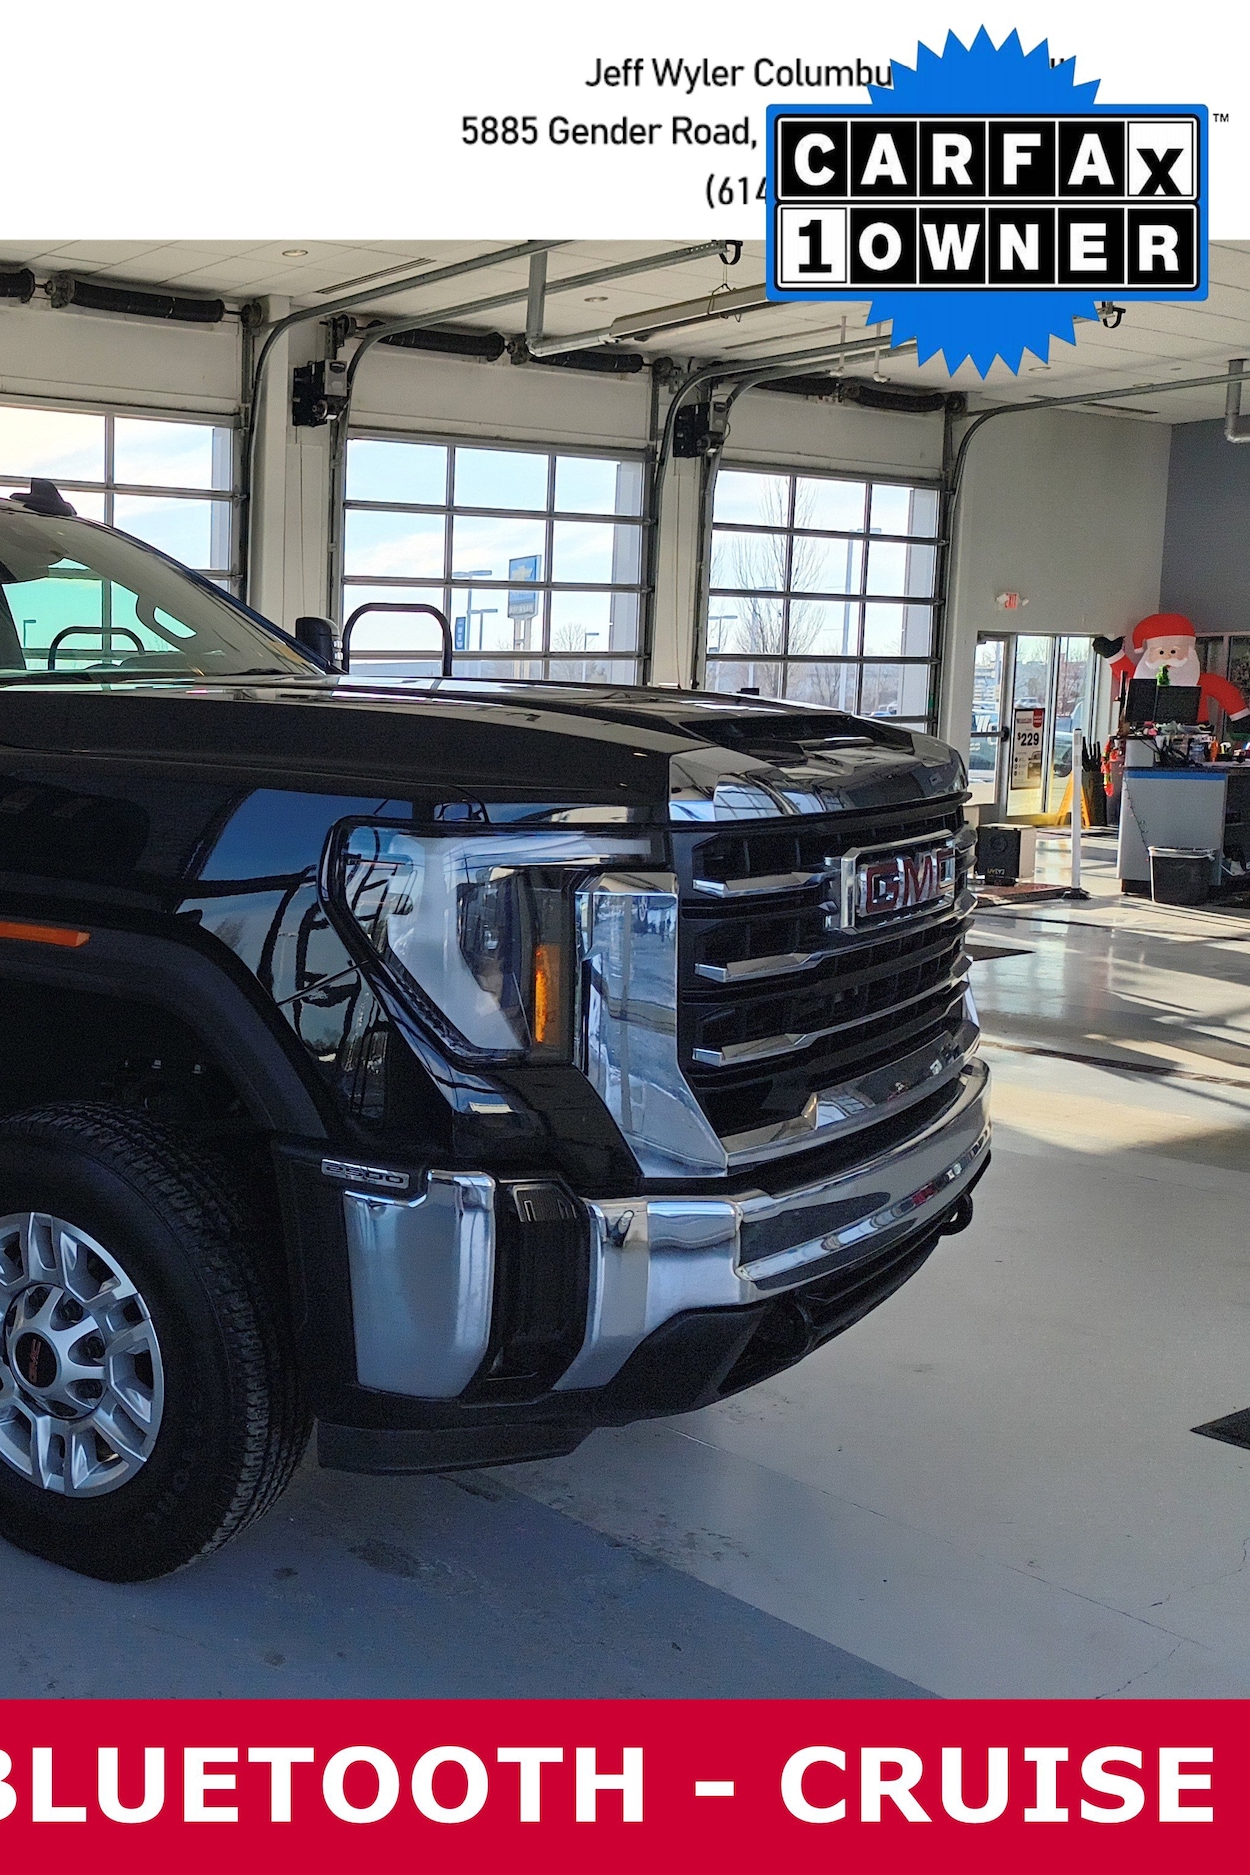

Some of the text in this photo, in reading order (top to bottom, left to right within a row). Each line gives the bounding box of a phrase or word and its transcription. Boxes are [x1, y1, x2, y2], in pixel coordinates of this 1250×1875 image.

[1017, 732, 1039, 746] $229
[858, 848, 955, 916] GMC
[324, 1161, 406, 1185] 2500
